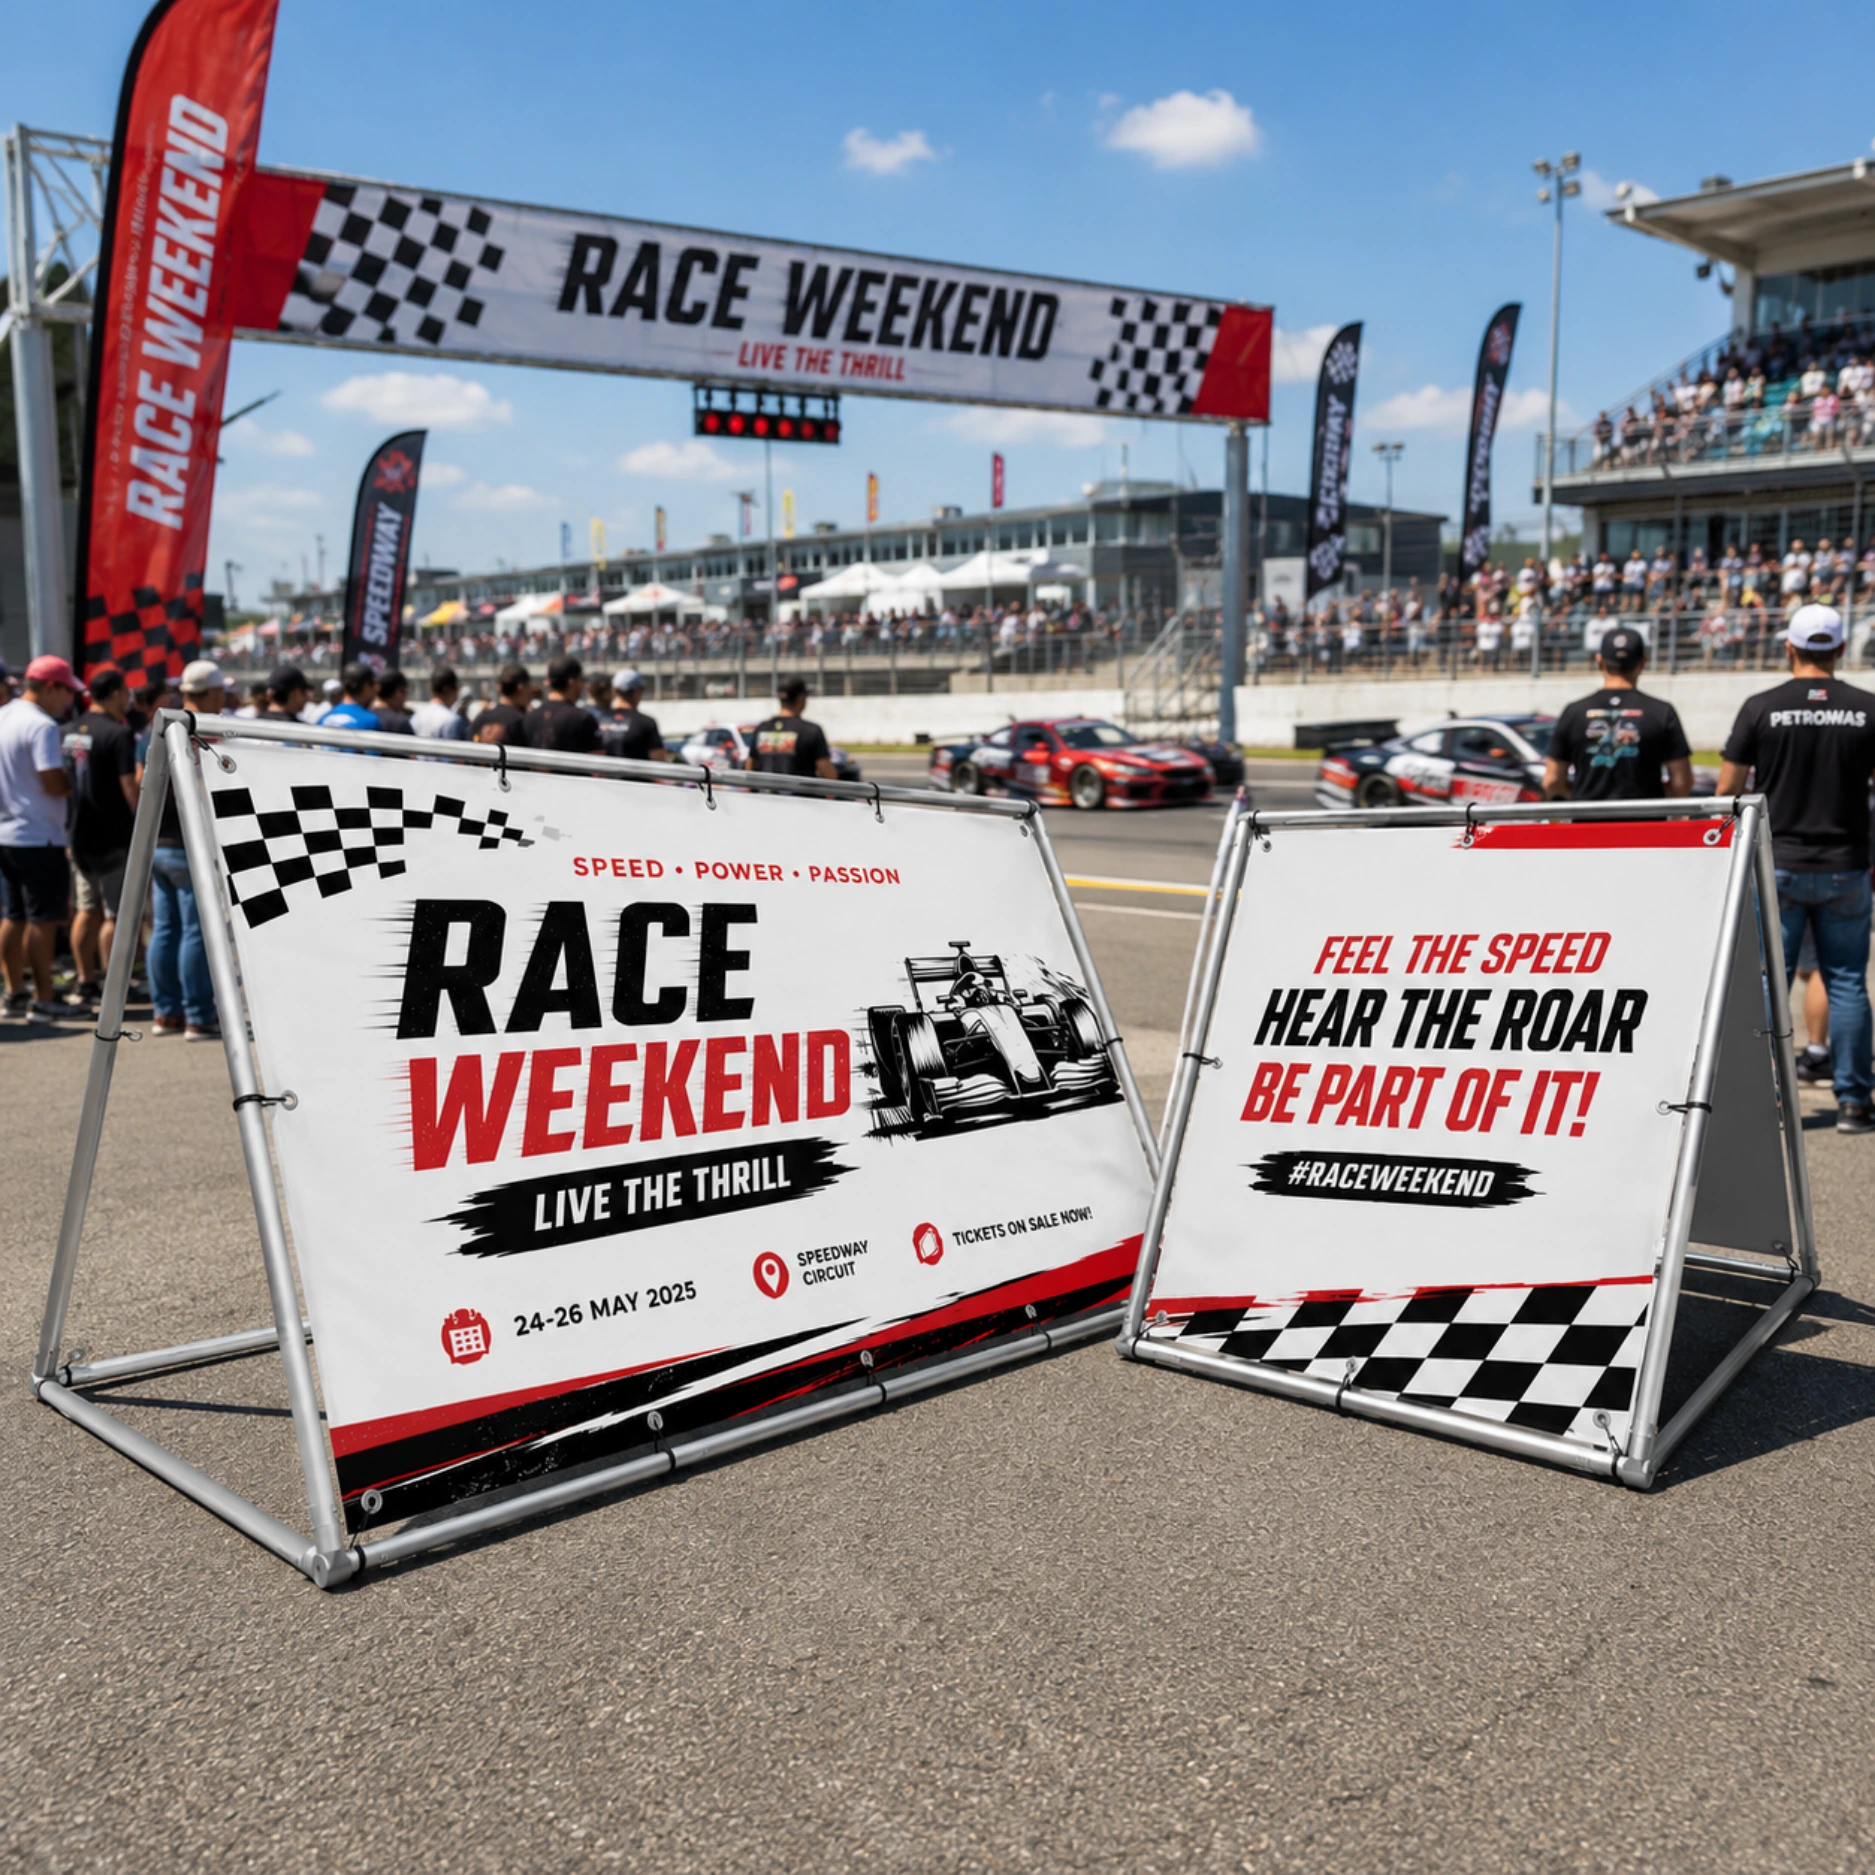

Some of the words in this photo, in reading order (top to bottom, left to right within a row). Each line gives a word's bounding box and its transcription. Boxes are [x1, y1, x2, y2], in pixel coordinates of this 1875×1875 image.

[141, 94, 228, 370] WEEKEND
[558, 233, 760, 330] RACE
[783, 260, 1061, 362] WEEKEND
[738, 341, 787, 371] LIVE
[796, 347, 833, 375] THE
[840, 352, 905, 381] THRILL
[126, 369, 196, 531] RACE
[362, 501, 403, 646] SPEEDWAY
[573, 857, 664, 877] SPEED
[695, 862, 784, 882] POWER
[809, 867, 901, 885] PASSION
[396, 898, 758, 1039] RACE
[1313, 935, 1395, 975] FEEL
[1405, 933, 1480, 974] THE
[1480, 932, 1612, 975] SPEED
[1253, 988, 1389, 1048] HEAR
[1392, 988, 1490, 1050] THE
[1489, 988, 1649, 1054] ROAR
[408, 1028, 851, 1172] WEEKEND
[1240, 1061, 1312, 1124] BE
[1307, 1063, 1447, 1130] PART
[1444, 1067, 1523, 1133] OF
[1519, 1070, 1602, 1138] IT!
[534, 1182, 612, 1232] LIVE
[623, 1171, 683, 1215] THE
[693, 1154, 792, 1202] THRILL
[1288, 1160, 1496, 1198] #RACEWEEKEND
[796, 1240, 869, 1268] SPEEDWAY
[952, 1223, 1006, 1247] TICKETS
[1007, 1219, 1028, 1237] ON
[1029, 1212, 1060, 1231] SALE
[1061, 1206, 1094, 1226] NOW!
[802, 1261, 857, 1286] CIRCUIT
[513, 1303, 584, 1337] 24-26
[590, 1291, 640, 1322] MAY
[645, 1280, 697, 1309] 2025
